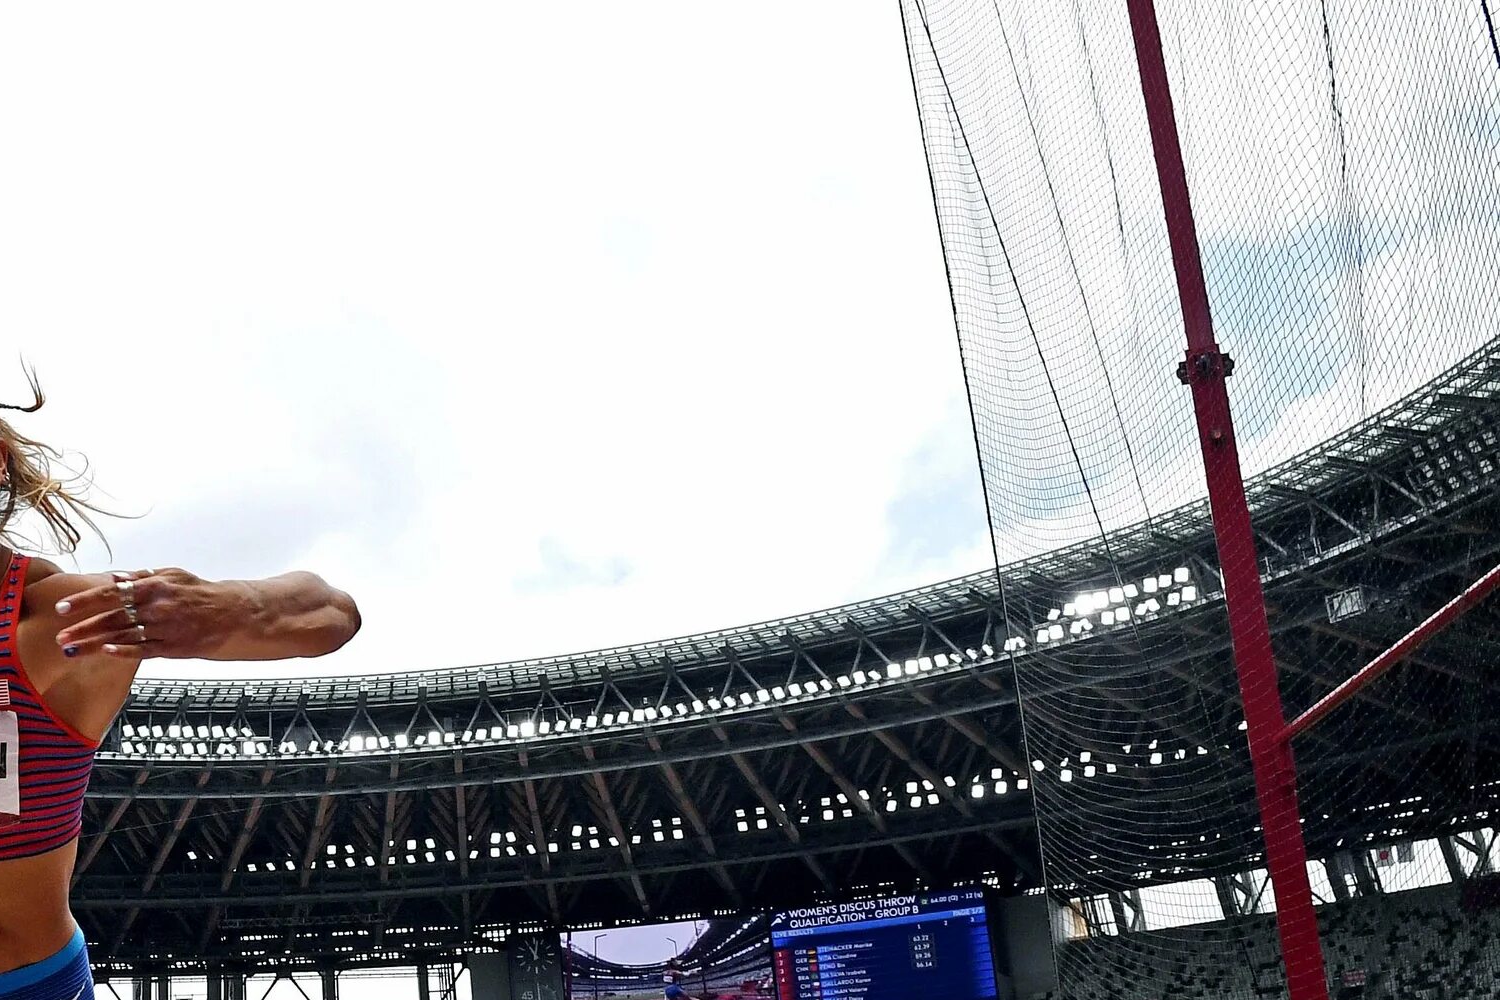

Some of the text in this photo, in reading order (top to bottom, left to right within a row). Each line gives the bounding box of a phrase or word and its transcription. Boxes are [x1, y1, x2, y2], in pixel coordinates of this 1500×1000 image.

[788, 895, 916, 918] WOMEN'S DISCUS THROW
[790, 911, 866, 928] QUALIFICATION
[875, 907, 911, 919] GROUP
[912, 905, 919, 914] B
